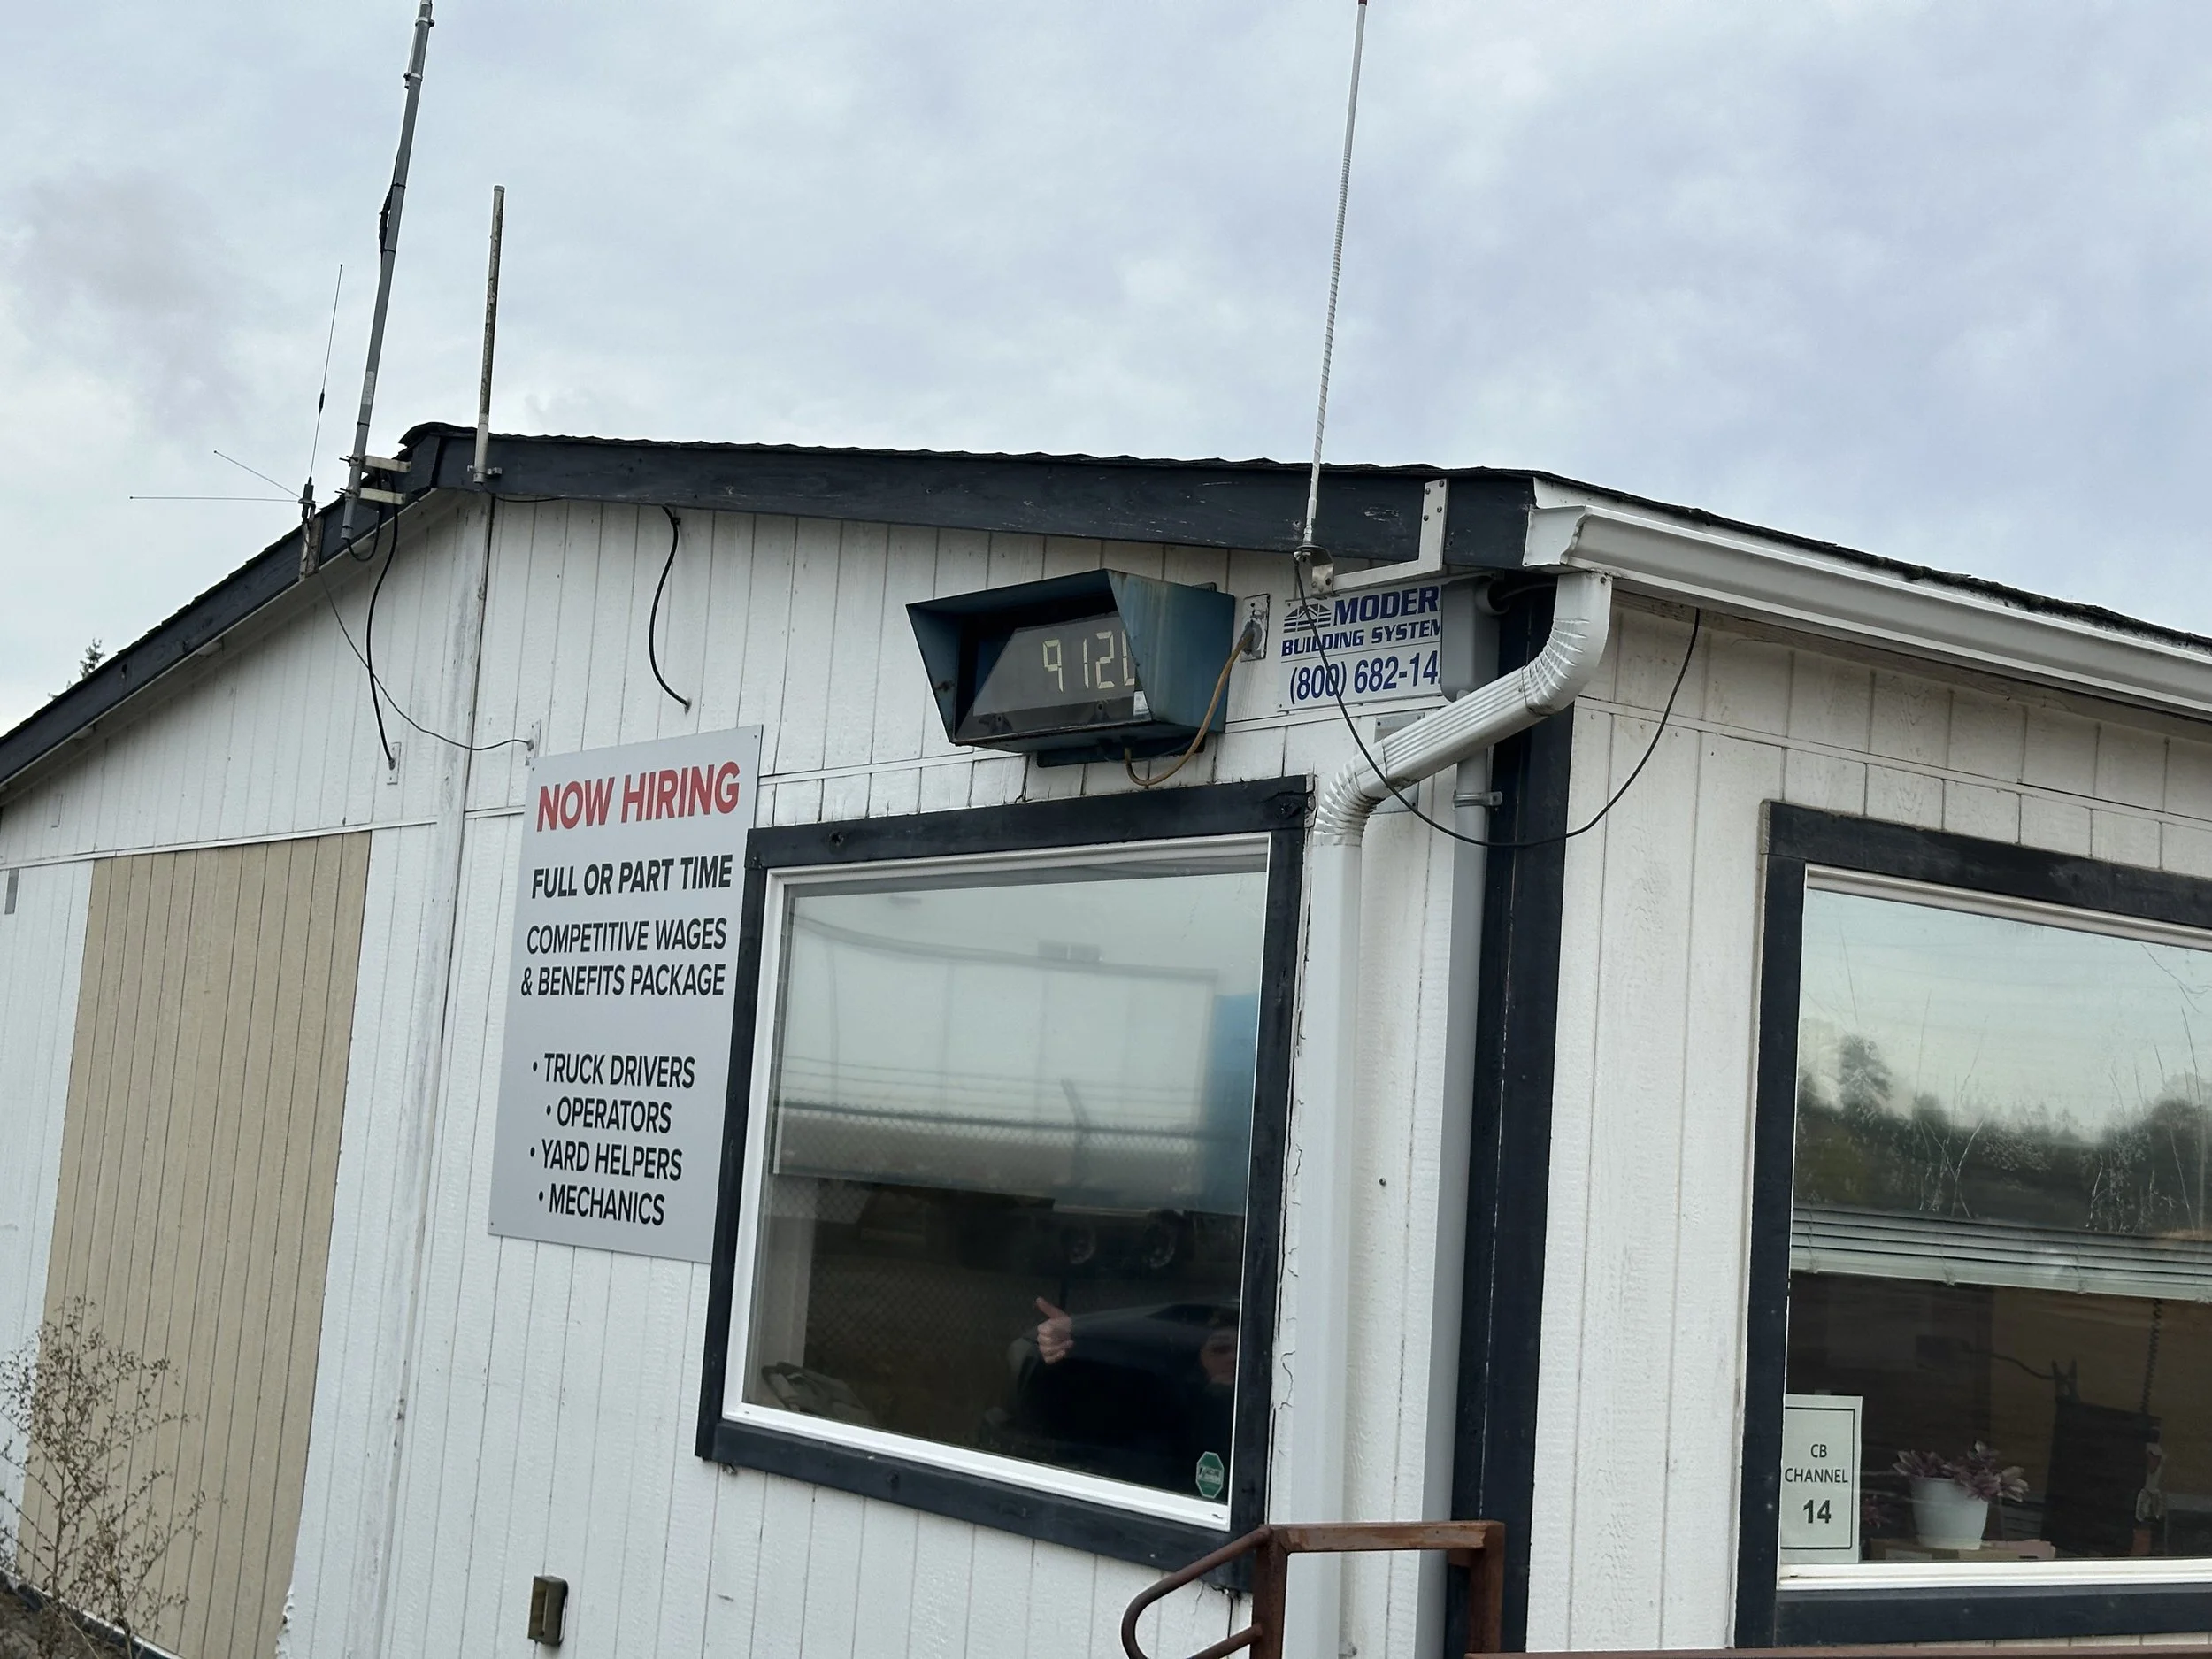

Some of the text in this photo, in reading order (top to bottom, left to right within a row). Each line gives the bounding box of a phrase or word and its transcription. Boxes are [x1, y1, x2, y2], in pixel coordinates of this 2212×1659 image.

[1333, 586, 1440, 626] MODER
[1281, 629, 1363, 657] BUILDING
[1290, 650, 1440, 704] (800) 682-14
[537, 761, 740, 832] NOW HIRING
[532, 854, 733, 899] FULL OR PART TIME
[527, 918, 727, 954] COMPETITIVE WAGES
[520, 964, 726, 995] & BENEFITS PACKAGE
[544, 1053, 695, 1089] TRUCK DRIVERS
[557, 1096, 672, 1133] OPERATORS
[541, 1139, 683, 1181] YARD HELPERS
[549, 1183, 665, 1226] MECHANICS
[1810, 1444, 1828, 1458] CB
[1785, 1468, 1848, 1483] CHANNEL
[1803, 1500, 1832, 1524] 14
